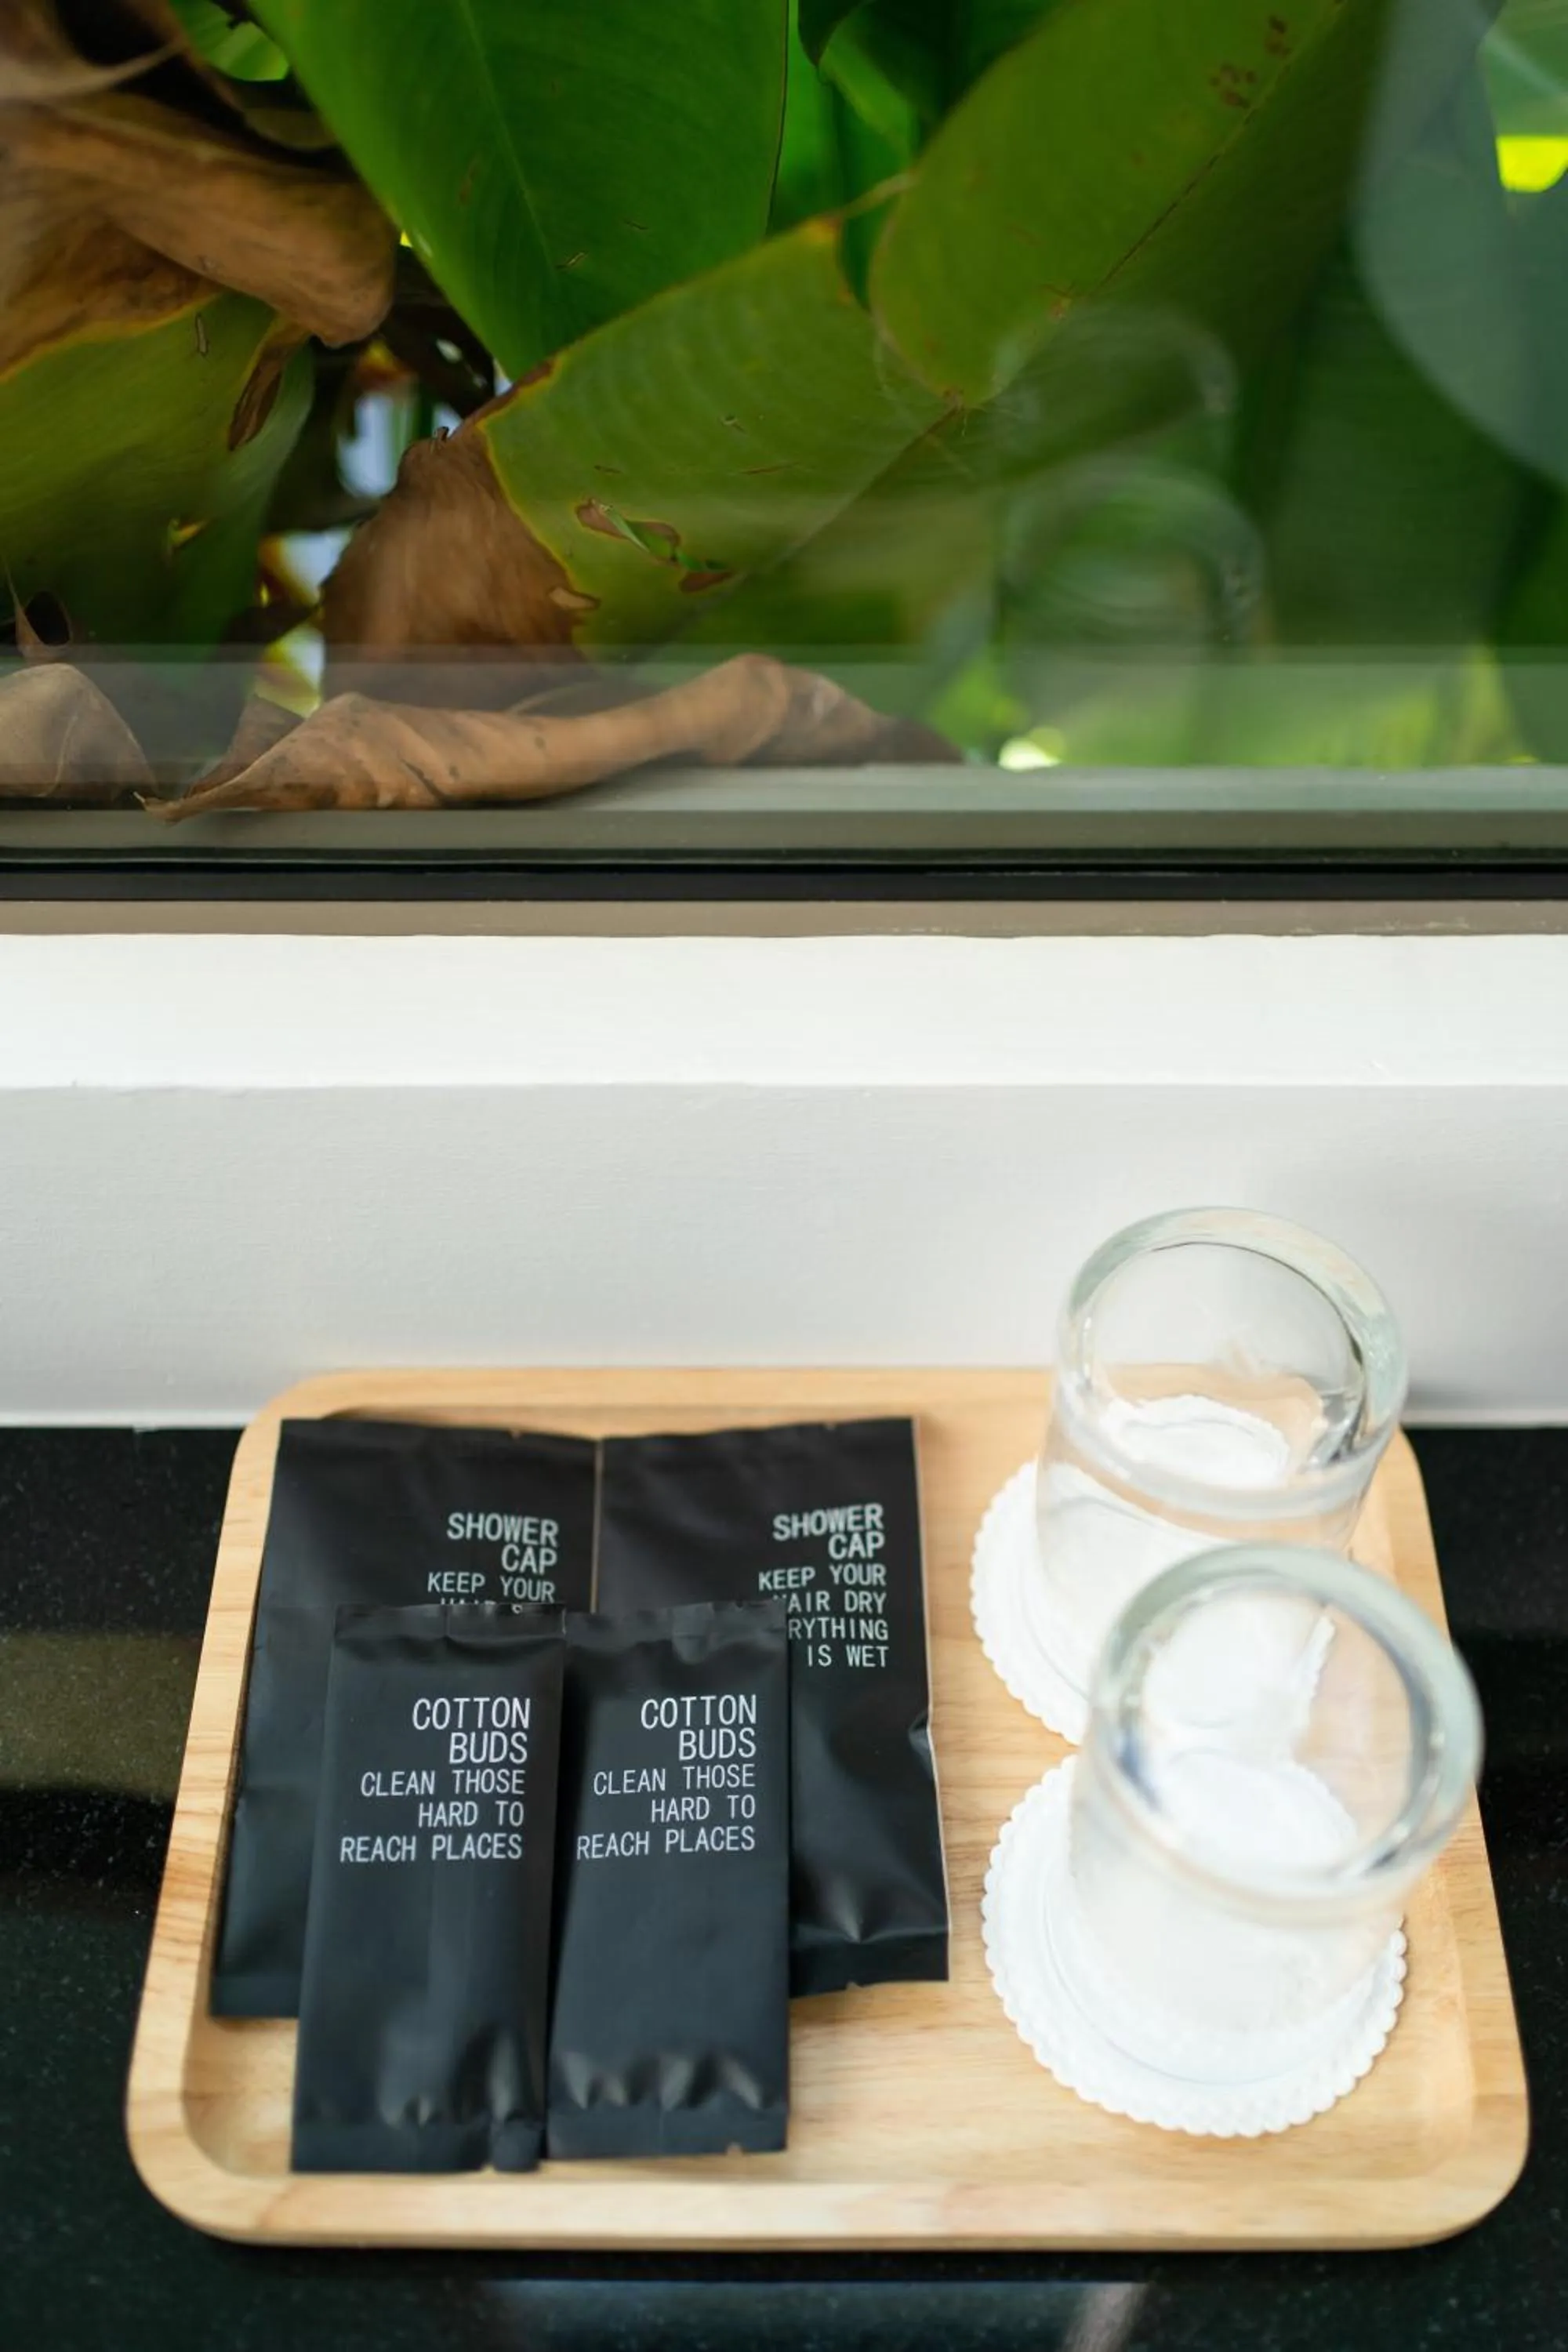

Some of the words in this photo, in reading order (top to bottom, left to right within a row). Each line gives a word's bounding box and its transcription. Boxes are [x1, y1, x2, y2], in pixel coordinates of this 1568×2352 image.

[446, 1512, 559, 1548] SHOWER
[772, 1502, 884, 1541] SHOWER
[501, 1544, 557, 1575] CAP
[828, 1531, 885, 1559] CAP
[427, 1571, 485, 1594] KEEP
[499, 1575, 555, 1603] YOUR
[758, 1566, 815, 1591] KEEP
[829, 1563, 887, 1587] YOUR
[773, 1590, 830, 1613] AIR
[844, 1590, 887, 1613] DRY
[788, 1617, 889, 1640] RYTHING
[808, 1644, 832, 1668] IS
[846, 1645, 889, 1668] WET
[412, 1697, 531, 1730] COTTON
[641, 1694, 757, 1730] COTTON
[449, 1731, 528, 1764] BUDS
[679, 1727, 756, 1761] BUDS
[360, 1769, 436, 1798] CLEAN
[451, 1768, 526, 1795] THOSE
[593, 1768, 666, 1796] CLEAN
[682, 1763, 756, 1790] THOSE
[418, 1801, 478, 1828] HARD
[495, 1800, 524, 1828] TO
[651, 1796, 710, 1824] HARD
[727, 1794, 756, 1820] TO
[339, 1835, 416, 1863] REACH
[431, 1833, 523, 1860] PLACES
[576, 1831, 650, 1861] REACH
[665, 1825, 756, 1854] PLACES
